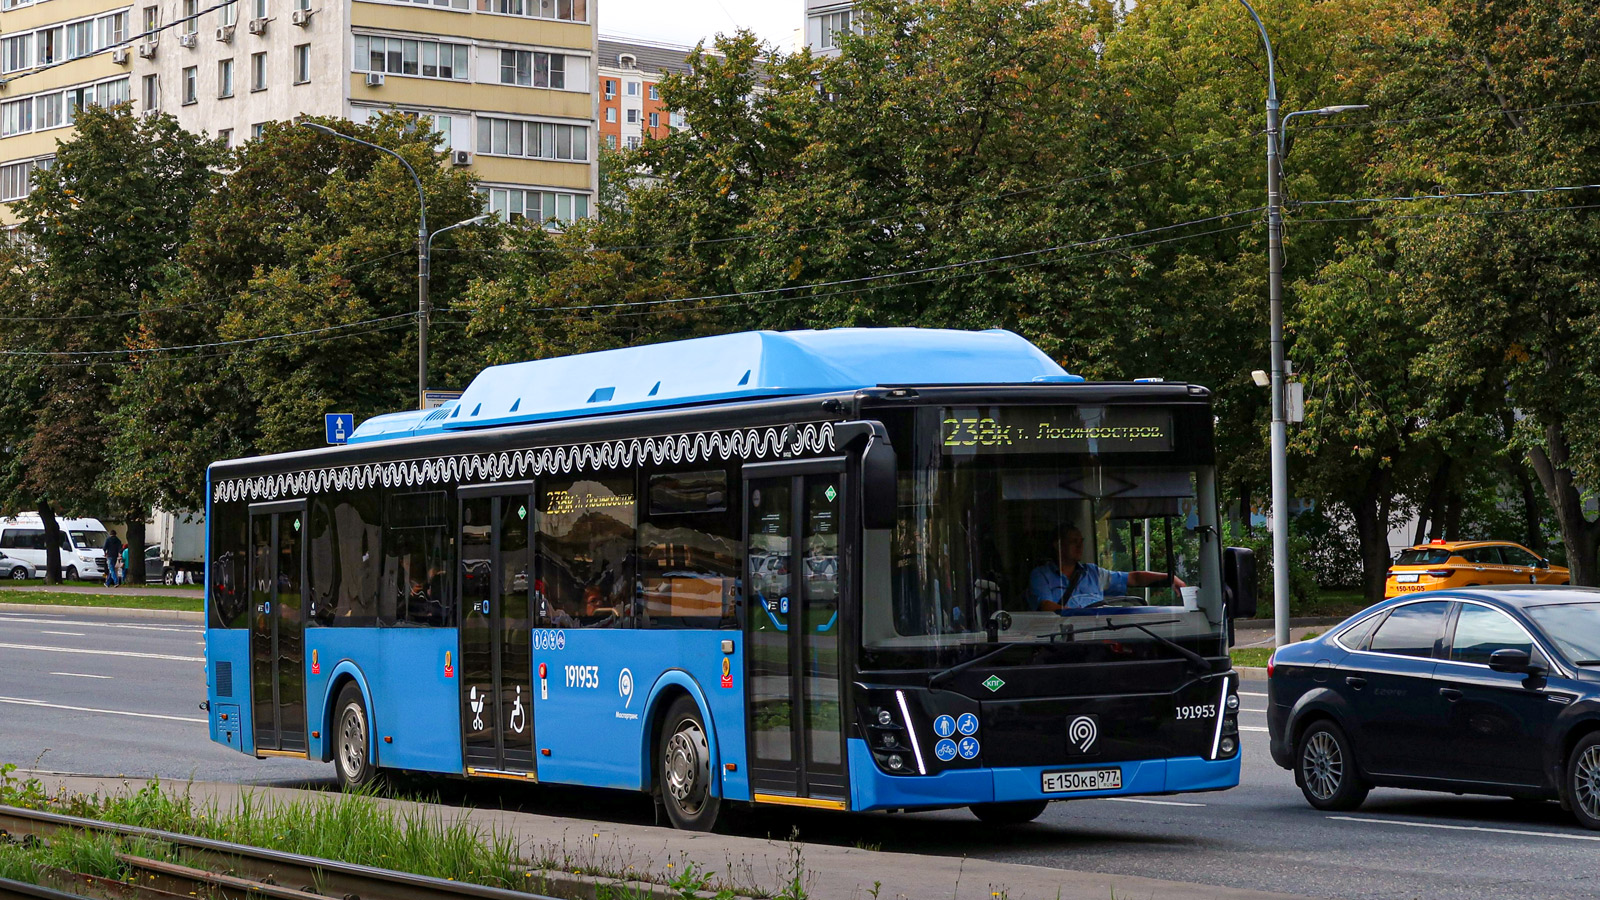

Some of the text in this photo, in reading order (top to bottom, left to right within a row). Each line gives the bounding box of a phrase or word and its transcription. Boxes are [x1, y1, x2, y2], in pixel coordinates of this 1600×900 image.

[564, 665, 599, 689] 191953
[1175, 704, 1216, 720] 191953
[1098, 771, 1117, 783] 977
